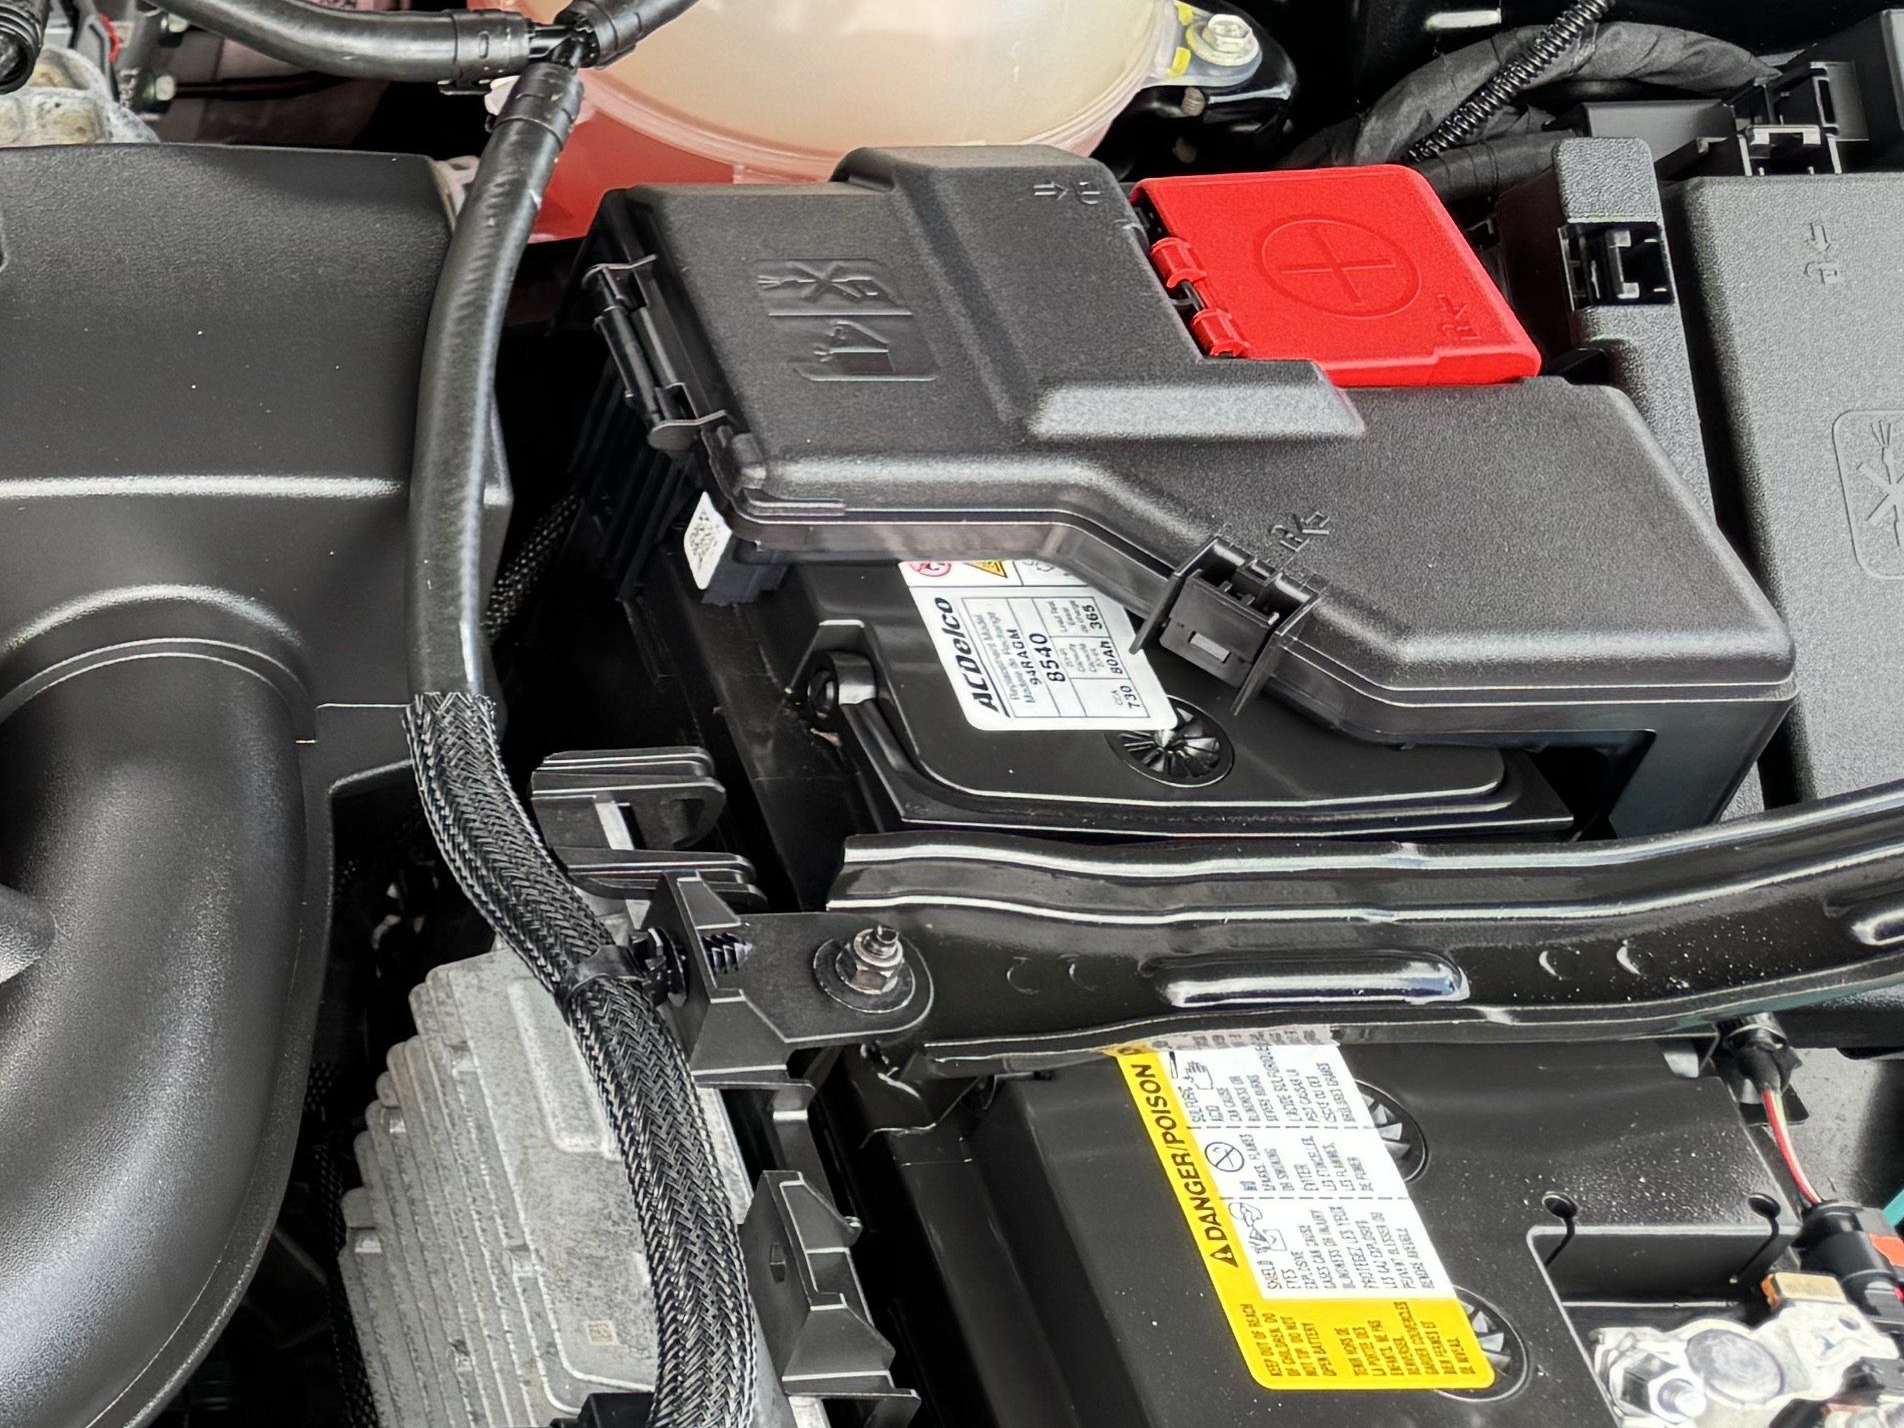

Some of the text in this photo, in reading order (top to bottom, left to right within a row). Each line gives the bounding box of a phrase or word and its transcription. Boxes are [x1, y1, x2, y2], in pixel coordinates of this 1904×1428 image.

[1081, 604, 1102, 629] 365
[934, 597, 997, 711] ACDelco
[1006, 628, 1041, 685] 94RAGM
[1028, 632, 1065, 682] 8540
[1099, 640, 1123, 674] 80Ah
[1119, 684, 1140, 708] 730
[1132, 1064, 1226, 1240] DANGER/POISON
